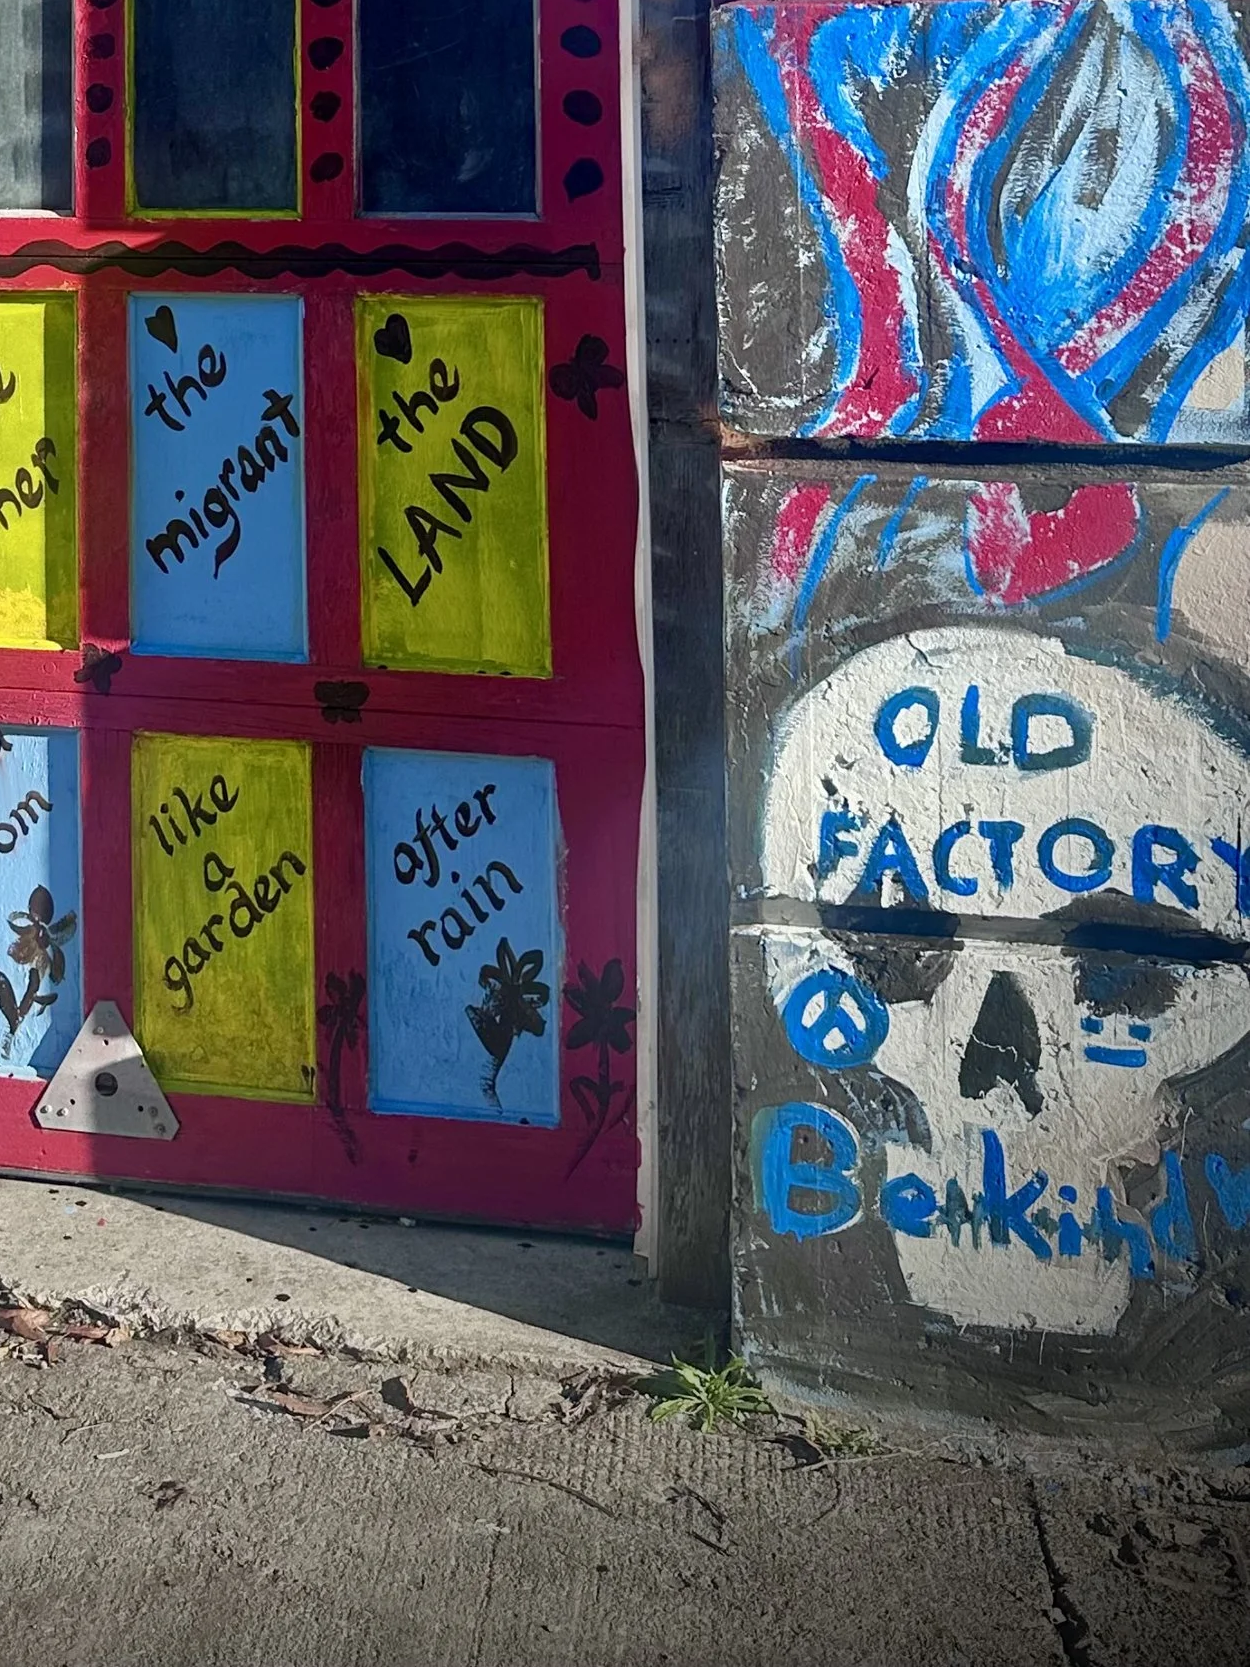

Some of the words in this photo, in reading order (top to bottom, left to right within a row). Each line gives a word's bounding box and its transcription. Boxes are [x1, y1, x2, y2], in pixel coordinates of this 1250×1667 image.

[145, 343, 228, 432] the
[377, 358, 461, 454] the
[146, 388, 301, 579] migrant
[377, 405, 519, 607] LAND
[873, 684, 1097, 772] OLD
[150, 773, 240, 858] like
[392, 783, 498, 890] after
[202, 851, 236, 893] a
[408, 859, 525, 967] rain
[161, 848, 308, 1015] garden
